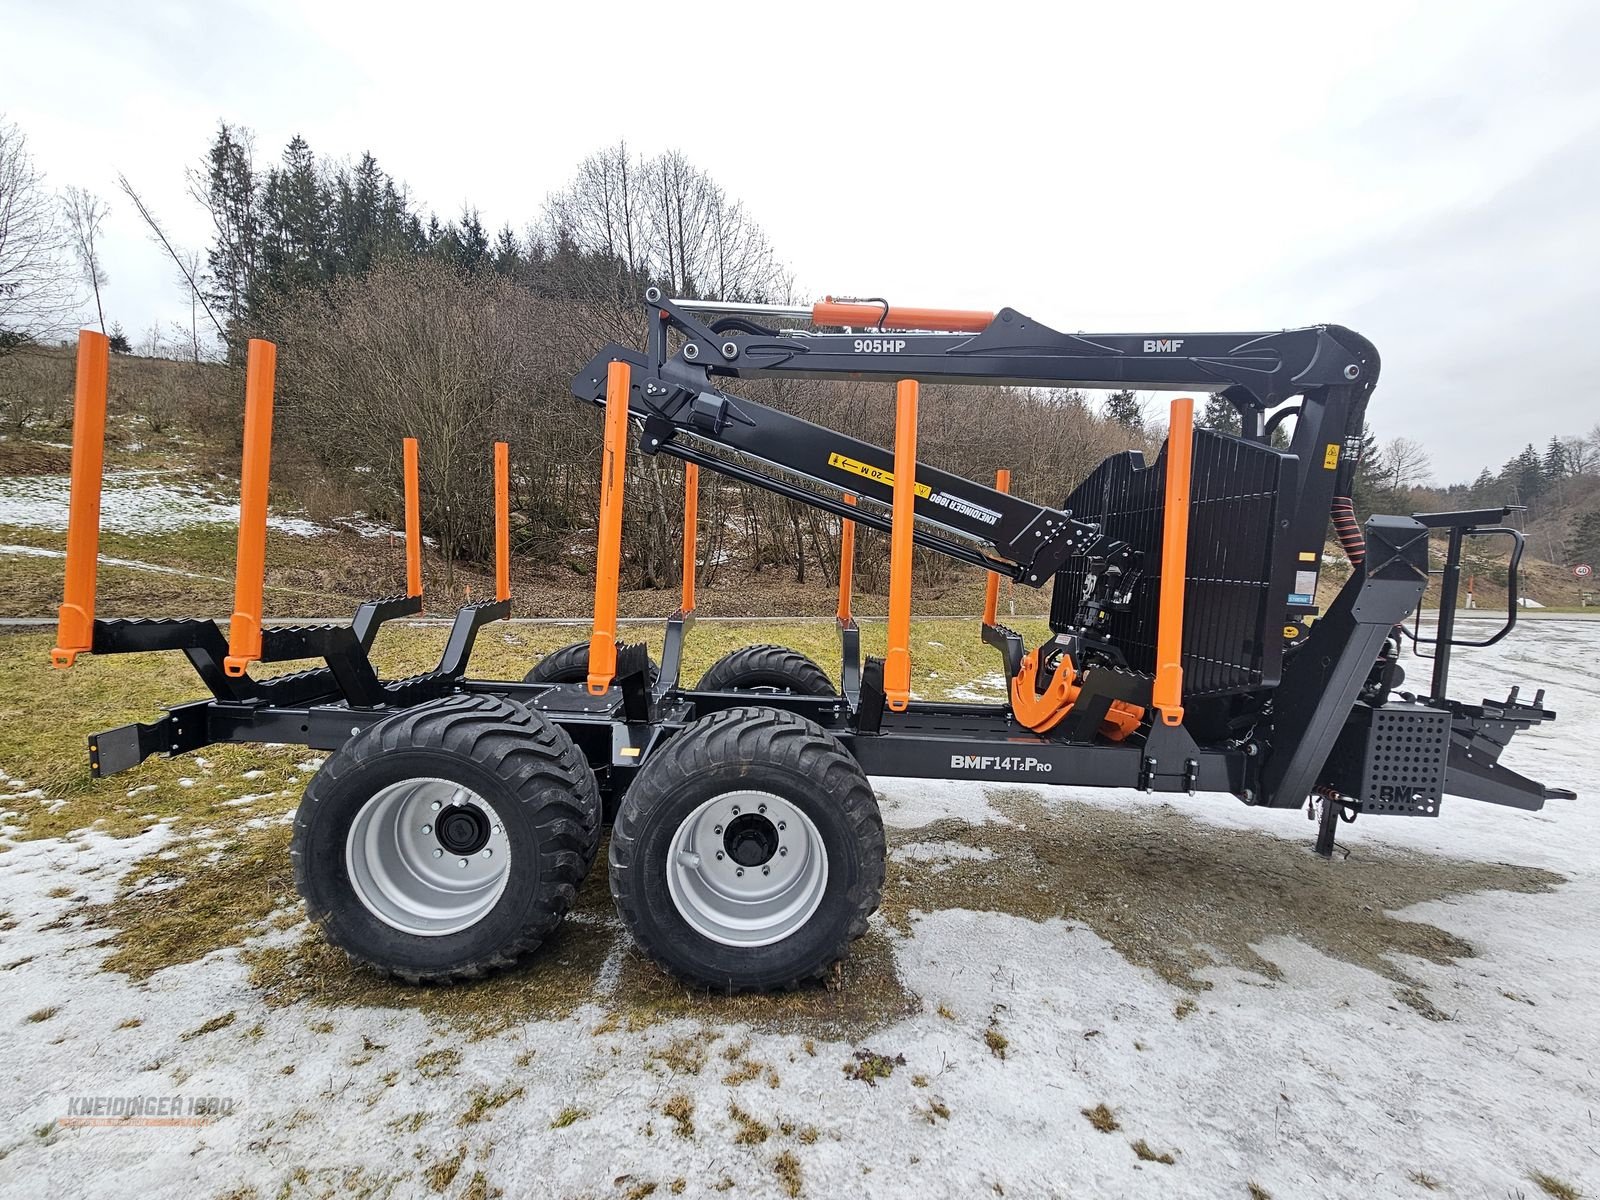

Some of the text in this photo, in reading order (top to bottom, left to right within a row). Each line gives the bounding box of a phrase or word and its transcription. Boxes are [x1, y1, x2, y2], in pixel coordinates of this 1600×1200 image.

[854, 339, 906, 353] 905HP
[1143, 338, 1184, 353] BMF
[860, 466, 883, 479] 20 M
[929, 493, 998, 526] KNEIDINGER 1880
[1380, 784, 1427, 804] BMF
